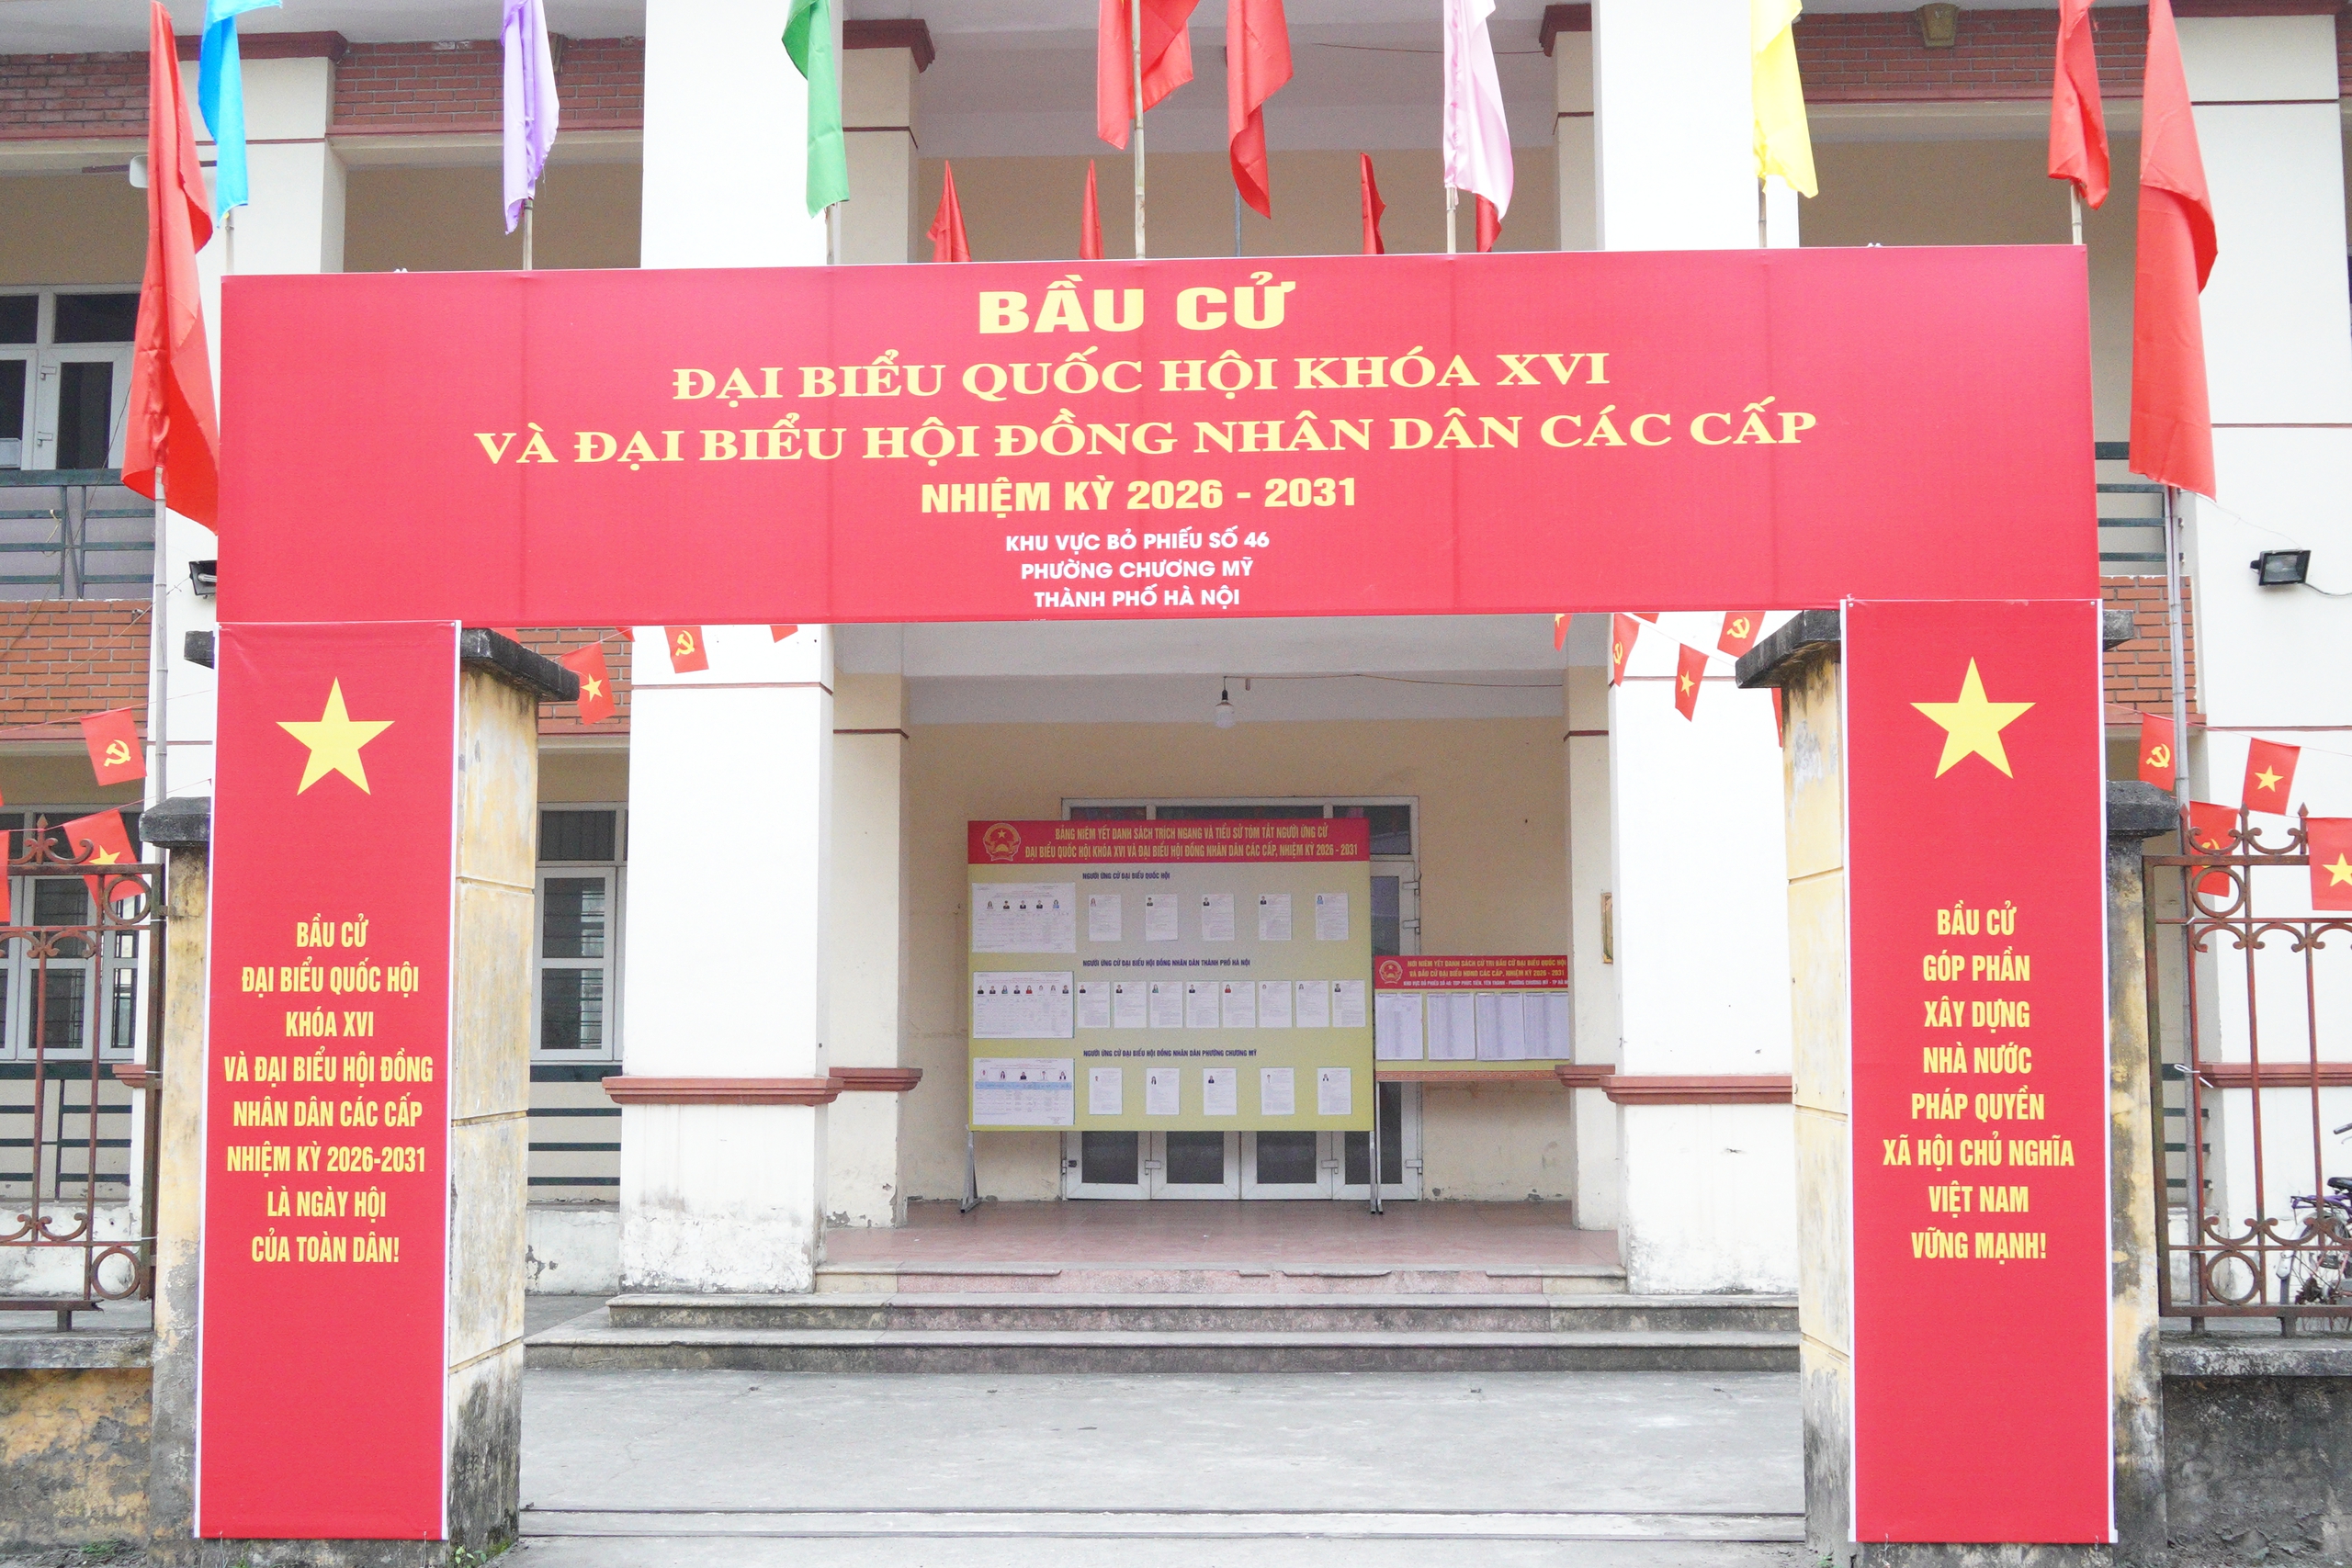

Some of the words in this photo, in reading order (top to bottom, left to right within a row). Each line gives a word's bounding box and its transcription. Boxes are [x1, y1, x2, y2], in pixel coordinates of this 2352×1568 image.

[979, 275, 1144, 333] BẦU
[1177, 271, 1295, 331] CỬ
[673, 367, 784, 408] ĐẠI
[798, 349, 946, 398] BIỂU
[962, 345, 1142, 401] QUỐC
[1159, 349, 1278, 399] HỘI
[1294, 345, 1480, 389] KHÓA
[1497, 353, 1610, 385] XVI
[474, 423, 559, 464] VÀ
[574, 431, 684, 470] ĐẠI
[699, 412, 847, 460] BIỂU
[863, 417, 979, 466] HỘI
[994, 408, 1178, 457] ĐỒNG
[1193, 410, 1374, 453] NHÂN
[1389, 408, 1522, 449] DÂN
[1541, 404, 1671, 447] CÁC
[1690, 396, 1817, 445] CẤP
[922, 477, 1050, 518] NHIỆM
[1065, 475, 1114, 511] KỲ
[1127, 479, 1223, 509] 2026
[1264, 478, 1354, 507] 2031
[1006, 536, 1048, 551] KHU
[1055, 532, 1100, 555] VỰC
[1107, 528, 1136, 549] BỎ
[1144, 526, 1202, 549] PHIẾU
[1209, 525, 1238, 548] SỐ
[1244, 532, 1270, 547] 46
[1022, 558, 1113, 579] PHƯỜNG
[1119, 559, 1216, 578] CHƯƠNG
[1222, 557, 1253, 576] MỸ
[1034, 587, 1105, 607] THÀNH
[1113, 584, 1158, 606] PHỐ
[1164, 585, 1194, 605] HÀ
[1201, 585, 1239, 609] NỘI
[1055, 826, 1075, 840] BẢNG
[1097, 824, 1110, 839] YẾT
[1112, 828, 1132, 839] DANH
[1134, 826, 1152, 839] SÁCH
[1177, 828, 1202, 839] NGANG
[1204, 825, 1213, 838] VÀ
[1215, 823, 1230, 838] TIỂU
[1233, 825, 1242, 838] SỬ
[1276, 824, 1298, 838] NGƯỜI
[1300, 824, 1316, 838] ỨNG
[1317, 824, 1328, 837] CỬ
[1025, 846, 1036, 860] ĐẠI
[1039, 842, 1055, 857] BIỂU
[1057, 841, 1076, 857] QUỐC
[1079, 843, 1091, 859] HỘI
[1092, 843, 1112, 857] KHÓA
[1114, 845, 1125, 856] XVI
[1126, 843, 1136, 856] VÀ
[1137, 845, 1150, 859] ĐẠI
[1152, 841, 1169, 856] BIỂU
[1170, 842, 1182, 859] HỘI
[1184, 840, 1204, 856] ĐỒNG
[1206, 842, 1227, 856] NHÂN
[1228, 842, 1243, 856] DÂN
[1245, 842, 1260, 855] CÁC
[1279, 841, 1303, 858] NHIỆM
[1305, 841, 1314, 855] KỲ
[1316, 844, 1333, 855] 2026
[1340, 844, 1357, 855] 2031
[297, 913, 334, 947] BẦU
[342, 913, 368, 947] CỬ
[1938, 900, 1979, 935] BẦU
[1986, 900, 2017, 935] CỬ
[242, 967, 274, 998] ĐẠI
[280, 956, 323, 992] BIỂU
[330, 957, 380, 995] QUỐC
[388, 961, 418, 998] HỘI
[1923, 950, 1965, 981] GÓP
[1973, 946, 2030, 981] PHẦN
[287, 1006, 337, 1037] KHÓA
[344, 1011, 373, 1036] XVI
[1925, 996, 1965, 1027] XÂY
[1973, 998, 2030, 1033] DỰNG
[224, 1051, 248, 1081] VÀ
[254, 1056, 287, 1088] ĐẠI
[293, 1046, 336, 1082] BIỂU
[344, 1051, 374, 1088] HỘI
[380, 1048, 433, 1082] ĐỒNG
[1924, 1042, 1967, 1073] NHÀ
[1974, 1042, 2031, 1074] NƯỚC
[233, 1096, 288, 1126] NHÂN
[294, 1096, 334, 1126] DÂN
[340, 1096, 378, 1126] CÁC
[385, 1092, 422, 1127] CẤP
[1912, 1088, 1968, 1119] PHÁP
[1975, 1085, 2044, 1122] QUYỀN
[228, 1141, 290, 1177] NHIỆM
[297, 1141, 321, 1171] KỲ
[327, 1146, 424, 1172] 2026-2031
[1883, 1134, 1911, 1165] XÃ
[1918, 1134, 1952, 1171] HỘI
[1961, 1131, 2002, 1166] CHỦ
[2009, 1135, 2075, 1166] NGHĨA
[267, 1186, 290, 1216] LÀ
[297, 1186, 348, 1216] NGÀY
[355, 1186, 386, 1223] HỘI
[1928, 1180, 1973, 1218] VIỆT
[1980, 1186, 2029, 1212] NAM
[252, 1227, 290, 1262] CỦA
[297, 1231, 346, 1262] TOÀN
[353, 1231, 399, 1262] DÂN!
[1911, 1227, 1968, 1258] VỮNG
[1975, 1233, 2046, 1264] MẠNH!
